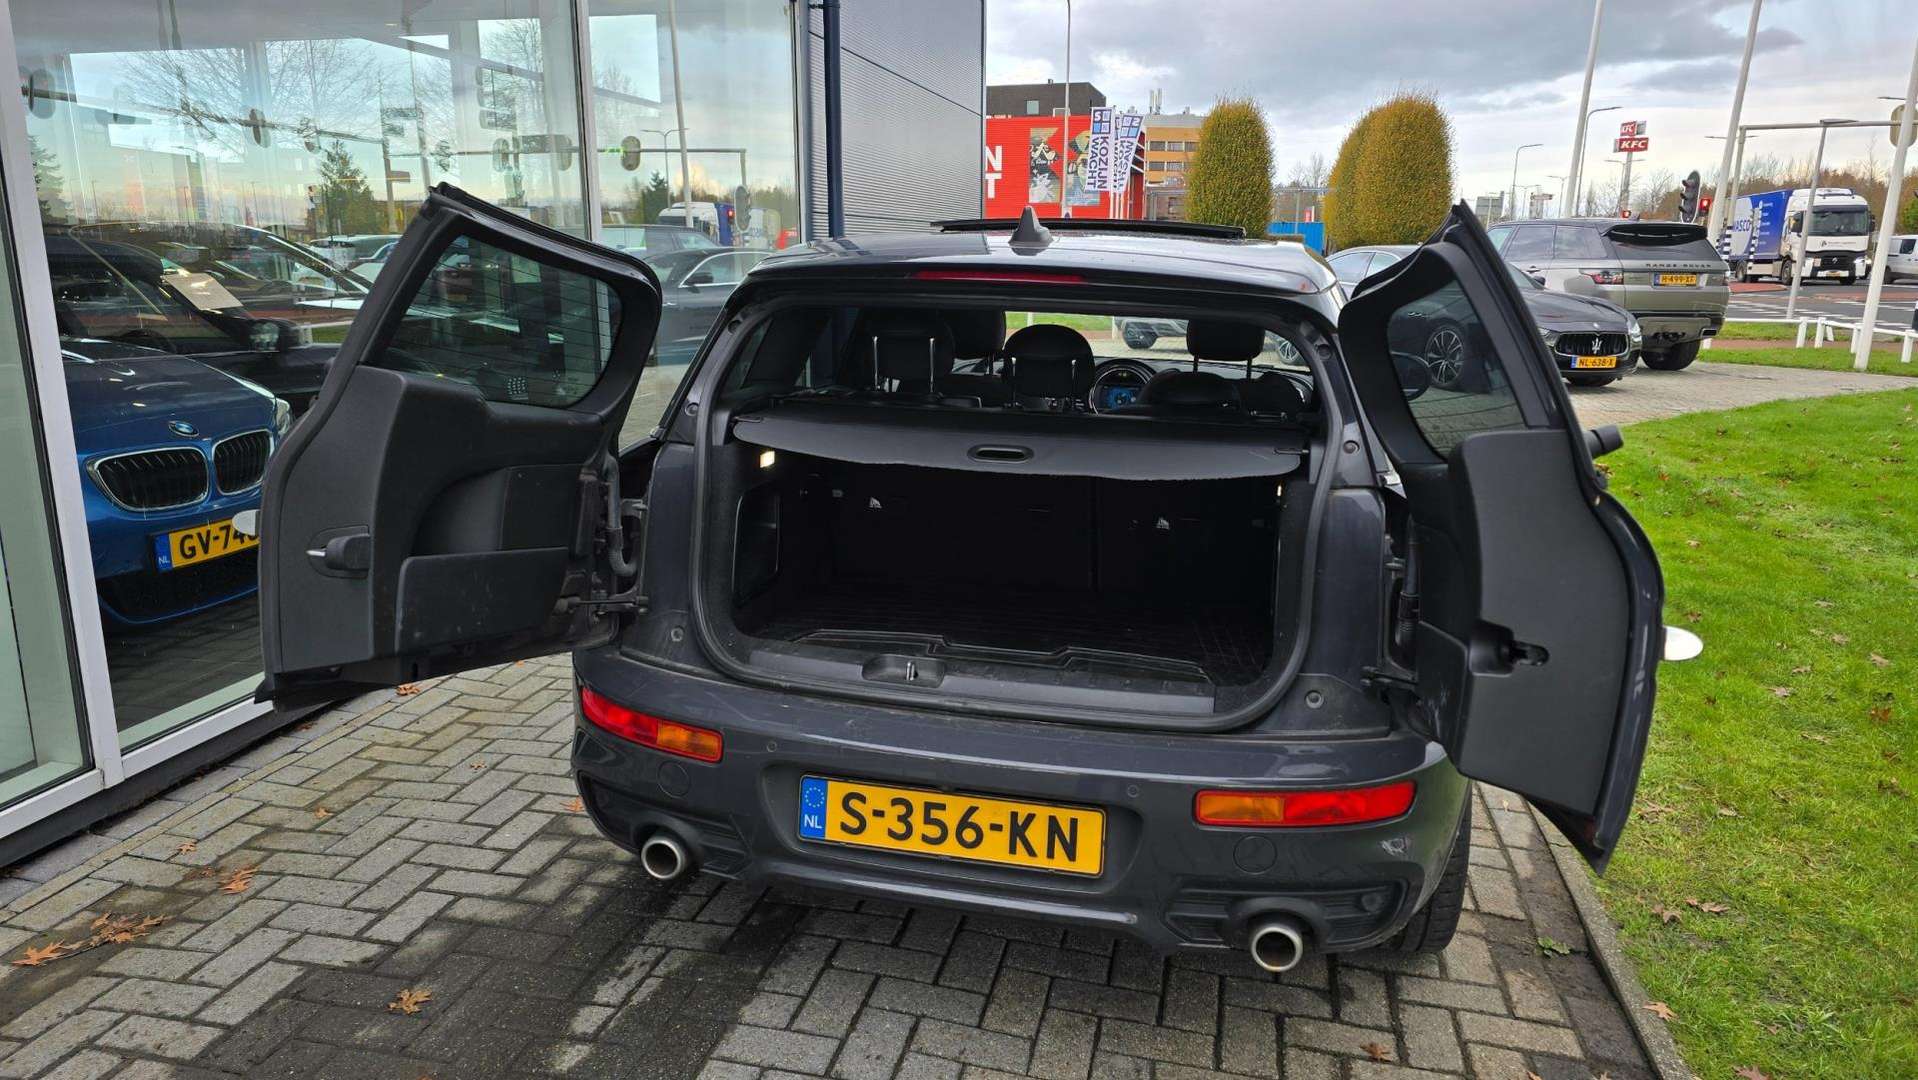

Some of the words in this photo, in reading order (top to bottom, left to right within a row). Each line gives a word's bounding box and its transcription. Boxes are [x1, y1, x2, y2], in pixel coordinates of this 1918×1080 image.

[1087, 137, 1100, 189] WACHT
[1097, 136, 1110, 189] KOZIJN
[1620, 140, 1648, 149] KFC
[804, 814, 822, 829] NL
[839, 791, 1079, 862] S-356-KN
